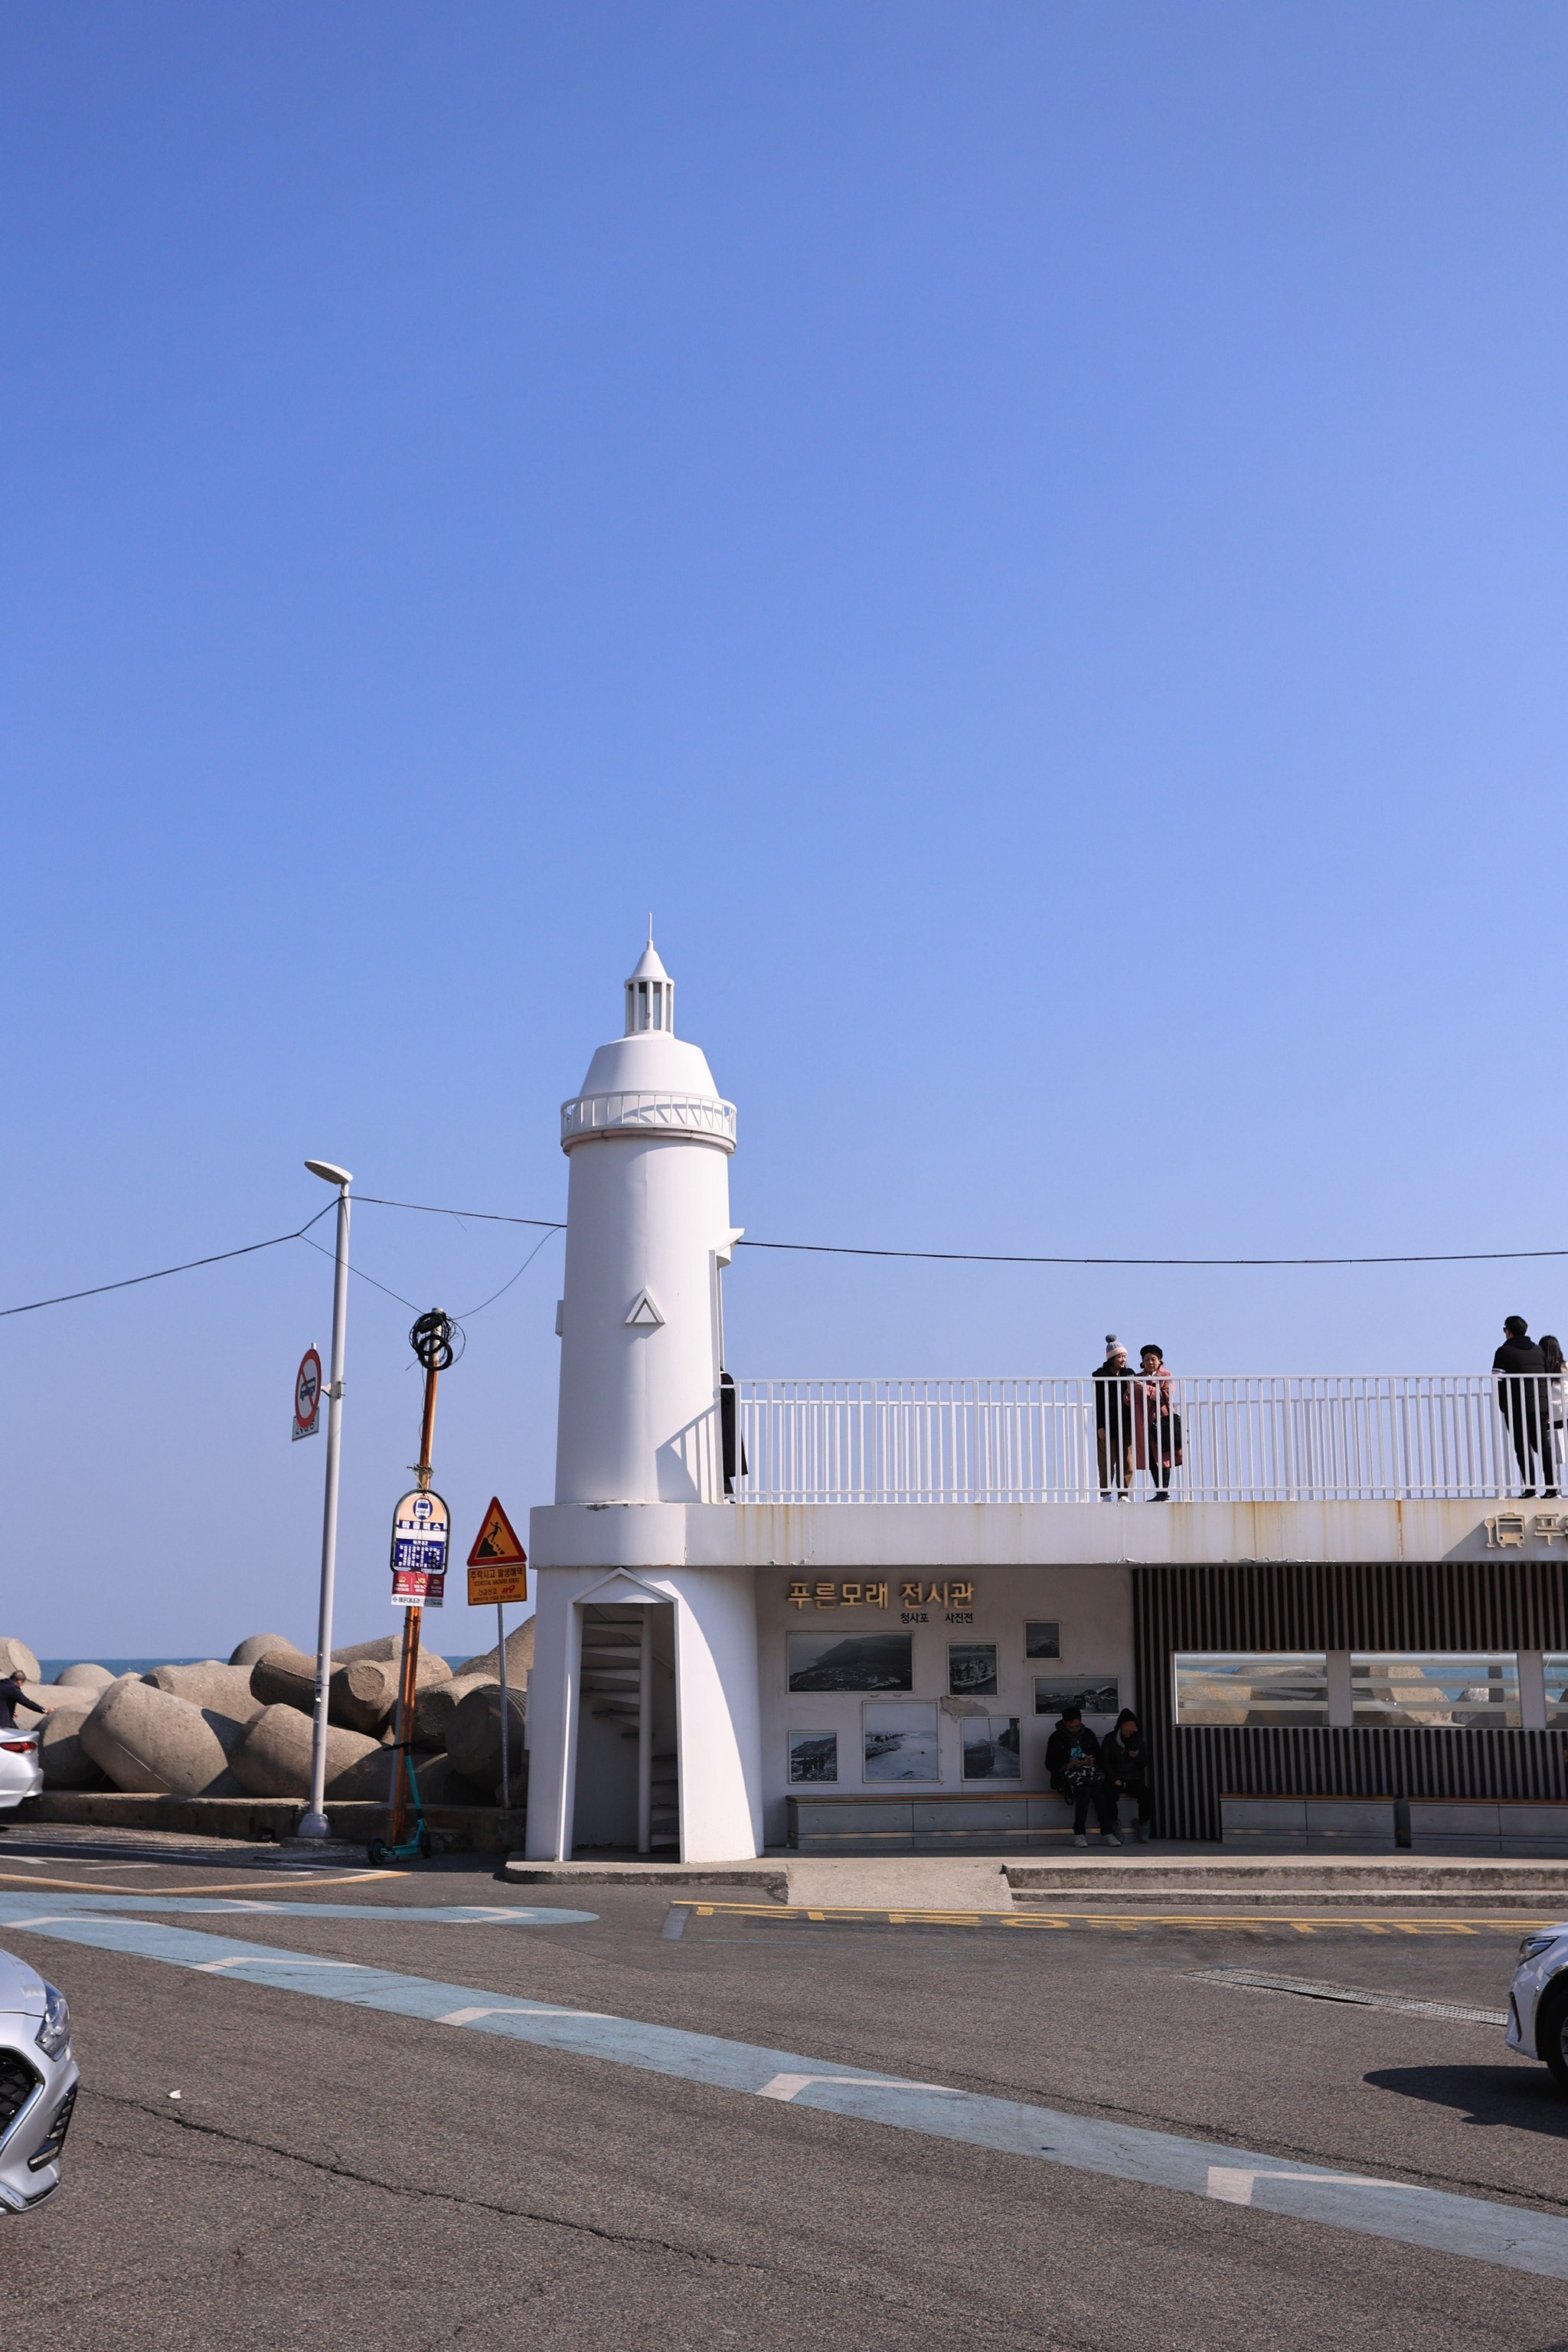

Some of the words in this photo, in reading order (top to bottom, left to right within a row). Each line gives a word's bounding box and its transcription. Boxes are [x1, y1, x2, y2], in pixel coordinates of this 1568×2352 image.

[402, 1521, 441, 1531] 마을버스
[1534, 1513, 1568, 1546] 푸
[470, 1569, 495, 1579] 추락사고
[501, 1585, 515, 1593] 119
[787, 1582, 889, 1609] 푸른모래
[900, 1582, 975, 1609] 전시관
[900, 1612, 929, 1624] 청사포
[945, 1612, 973, 1624] 사진전
